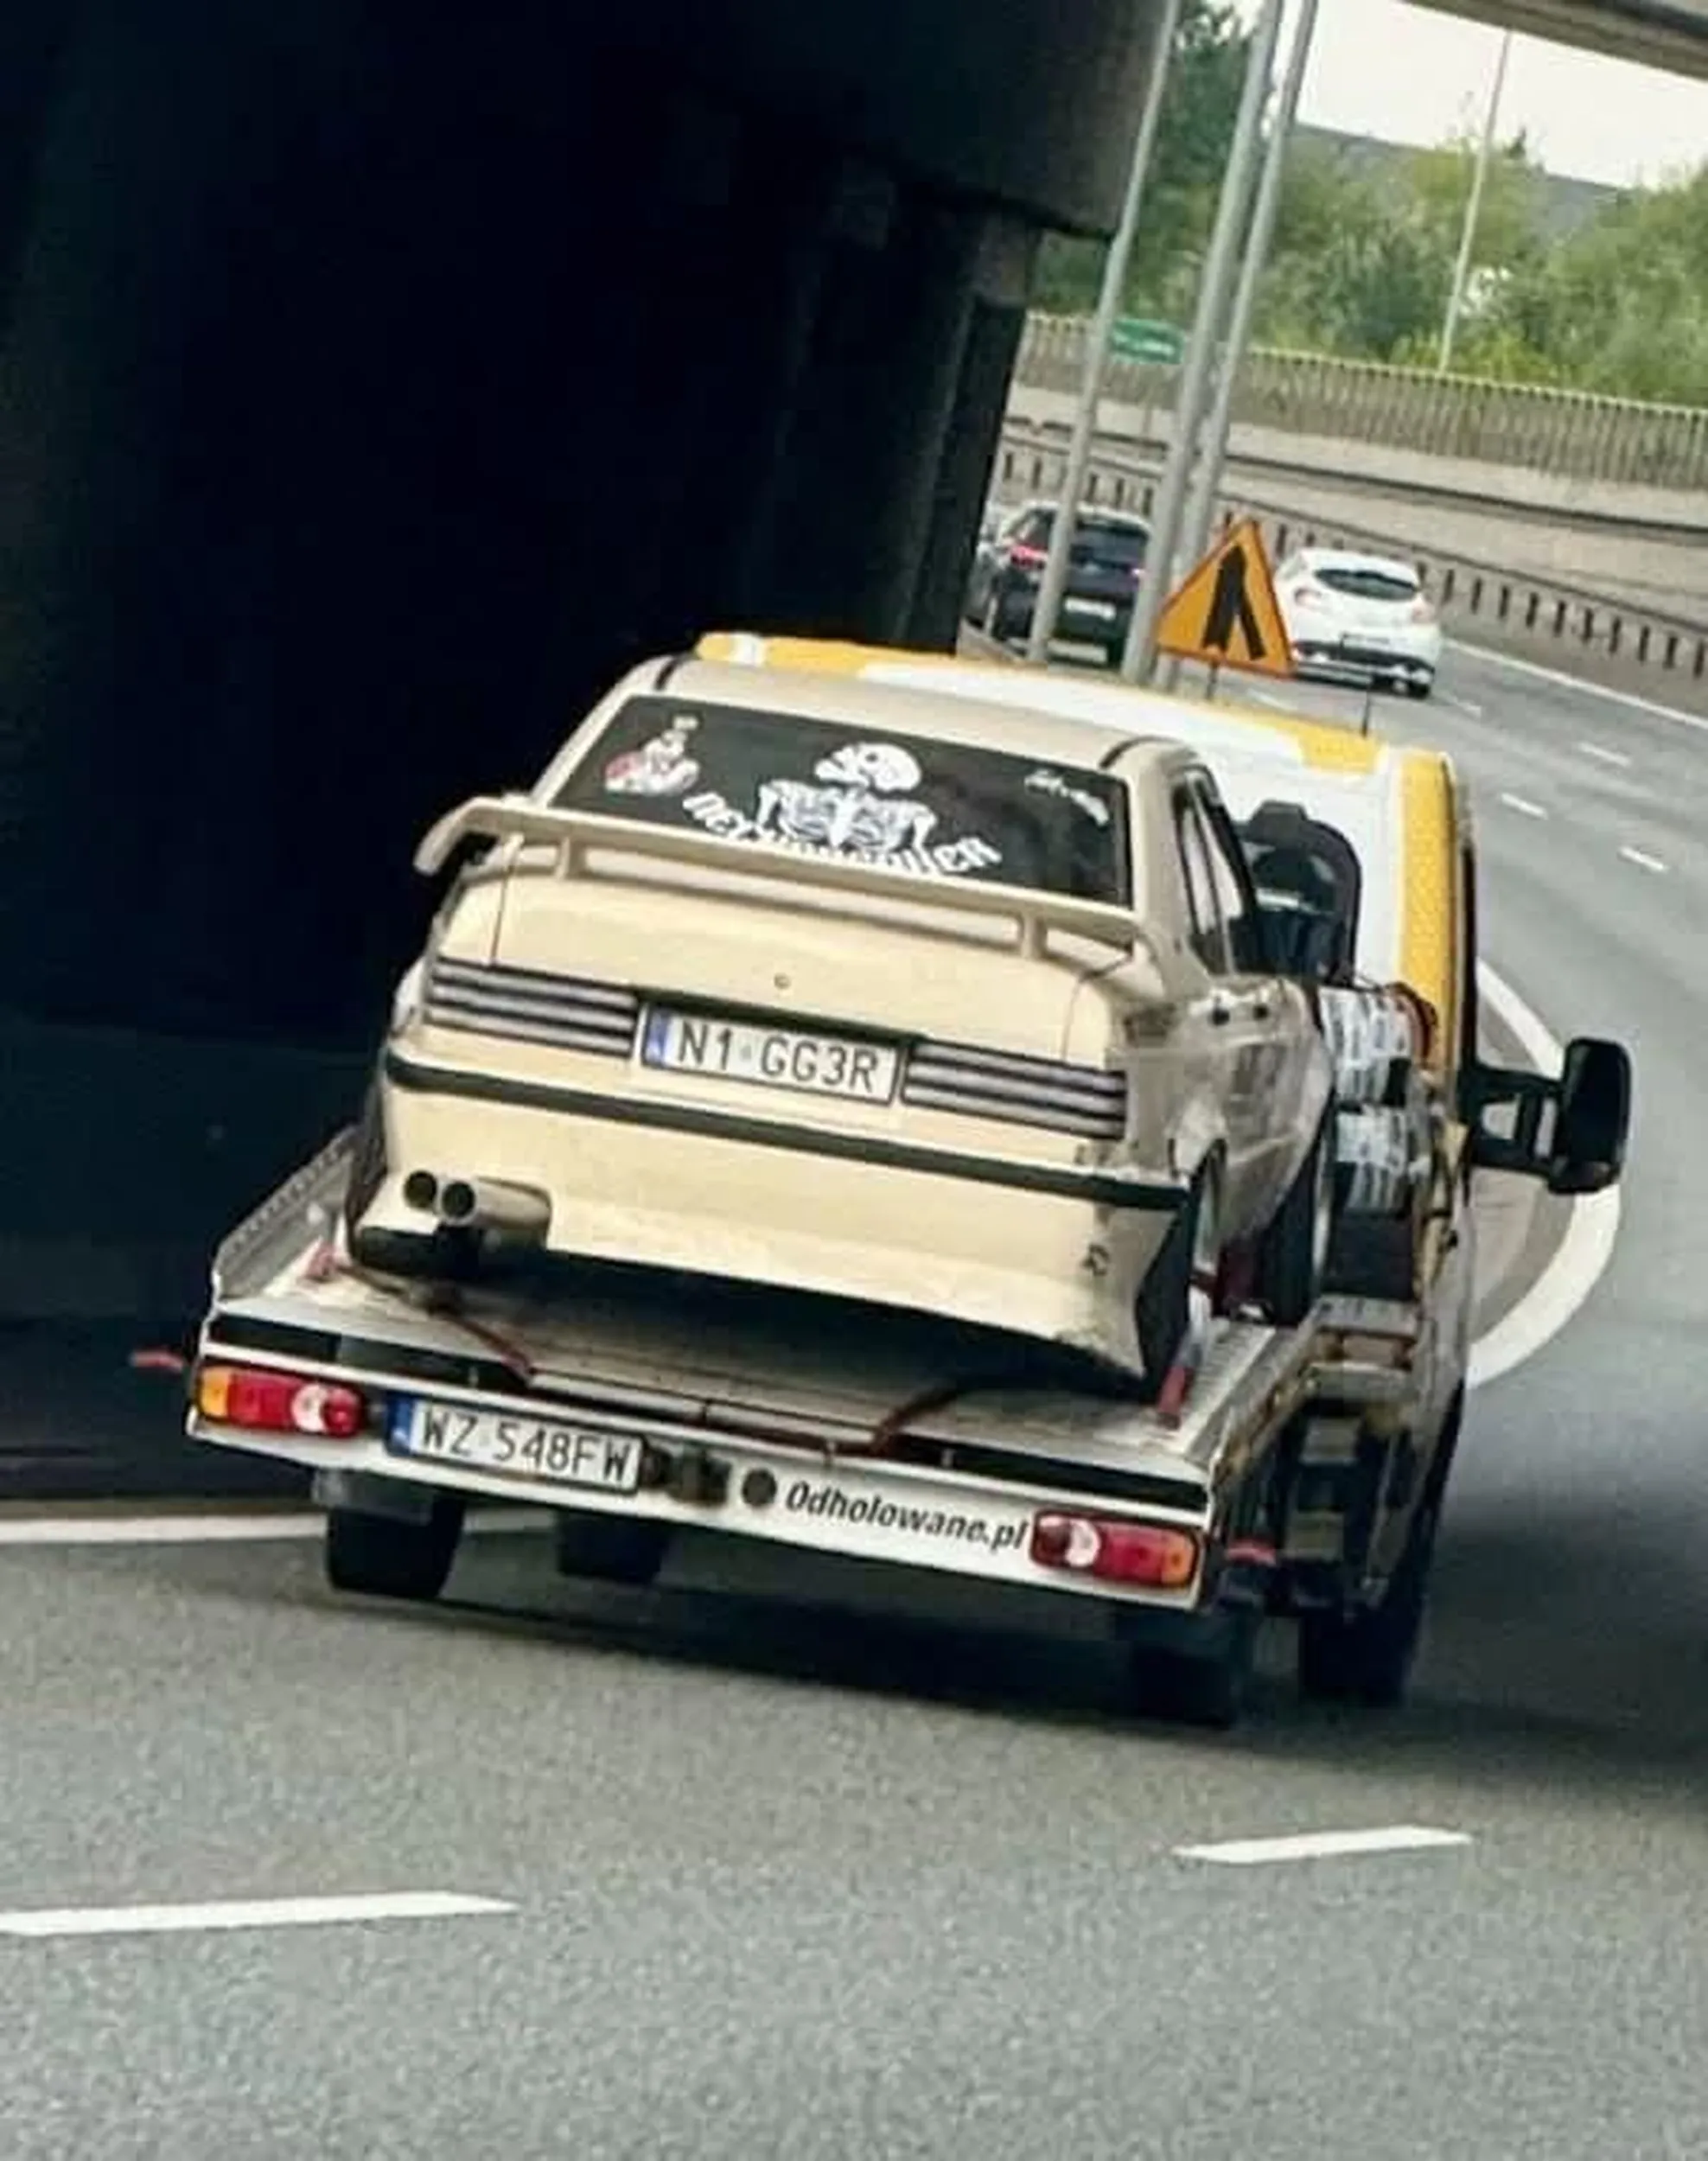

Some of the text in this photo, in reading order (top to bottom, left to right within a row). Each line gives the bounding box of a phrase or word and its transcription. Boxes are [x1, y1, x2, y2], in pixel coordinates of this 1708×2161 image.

[679, 1020, 879, 1093] N1 GG3R
[423, 1409, 630, 1481] WZ 548FW
[787, 1481, 1029, 1551] Odholowane.pl
